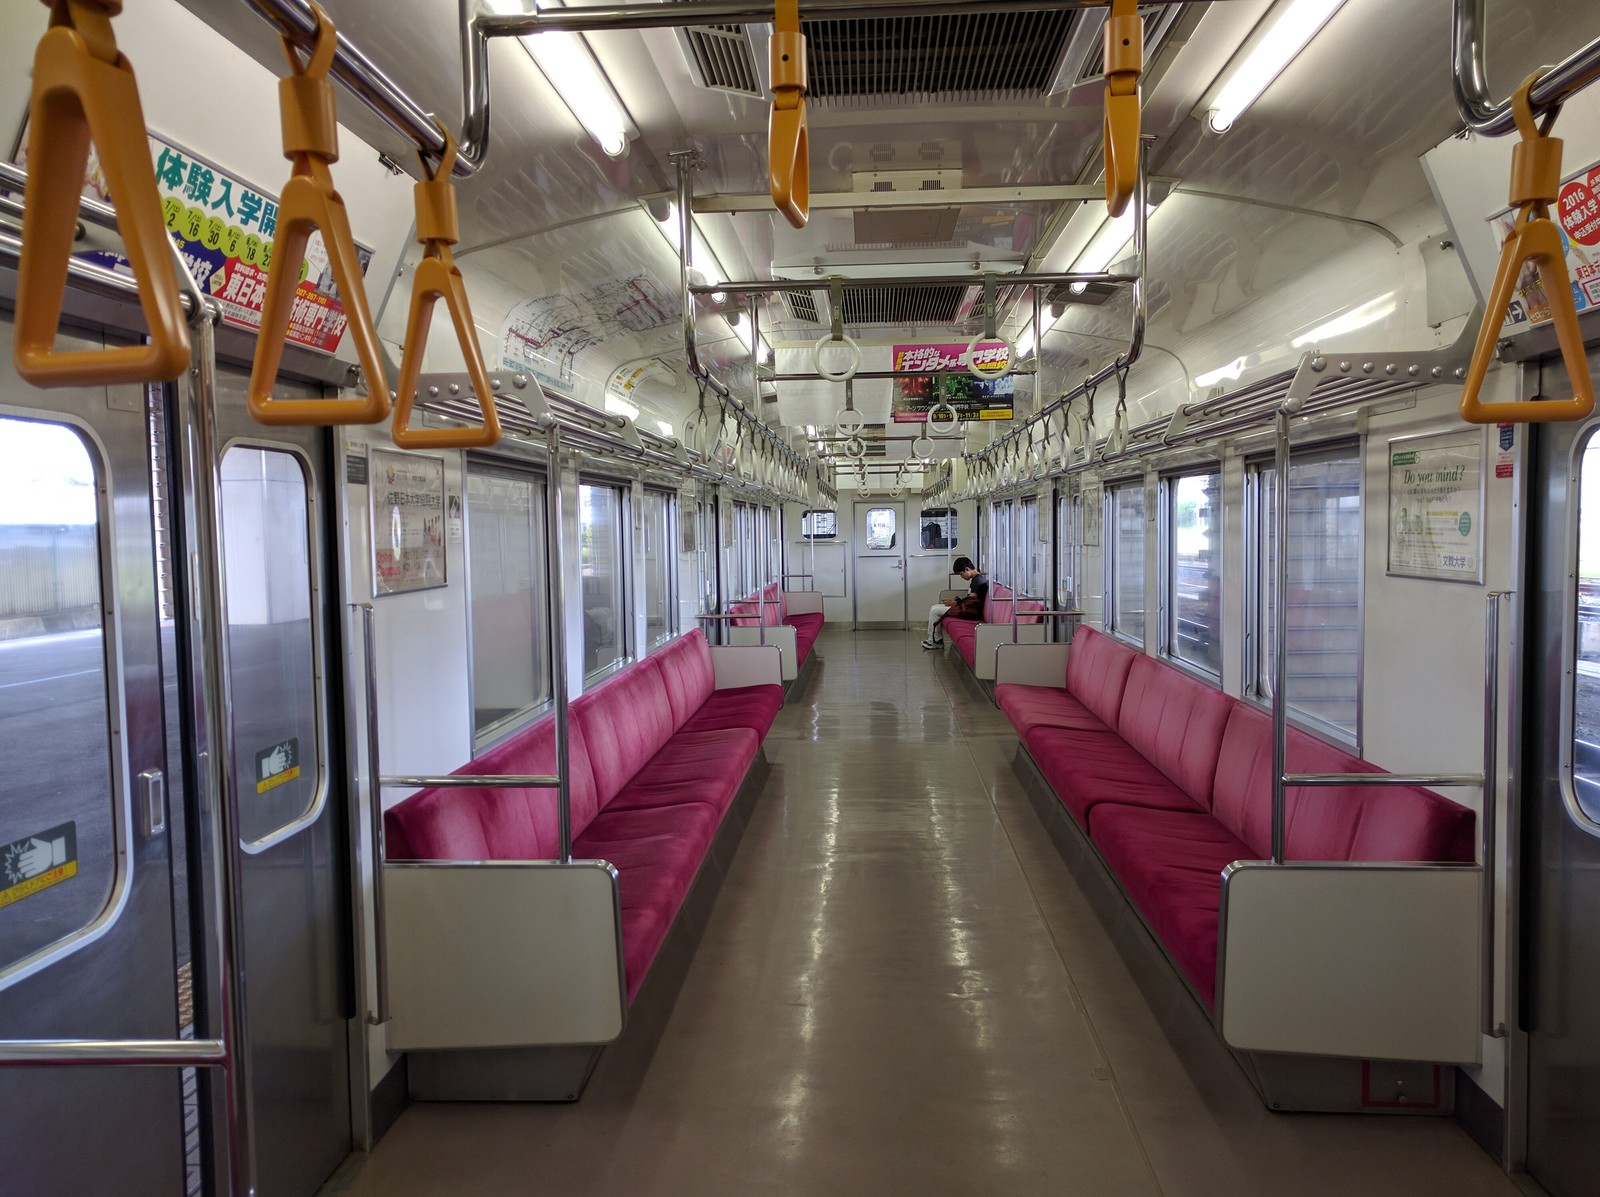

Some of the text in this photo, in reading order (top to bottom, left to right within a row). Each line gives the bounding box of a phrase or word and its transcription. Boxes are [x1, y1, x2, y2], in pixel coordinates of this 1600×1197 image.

[1562, 188, 1585, 210] 2016
[1563, 199, 1598, 230] 体験入学
[188, 221, 200, 237] 16
[207, 230, 220, 245] 30
[246, 247, 257, 261] 18
[903, 347, 941, 361] 本格的な
[1403, 464, 1466, 487] Do you mind?
[1442, 554, 1466, 568] 文教大学
